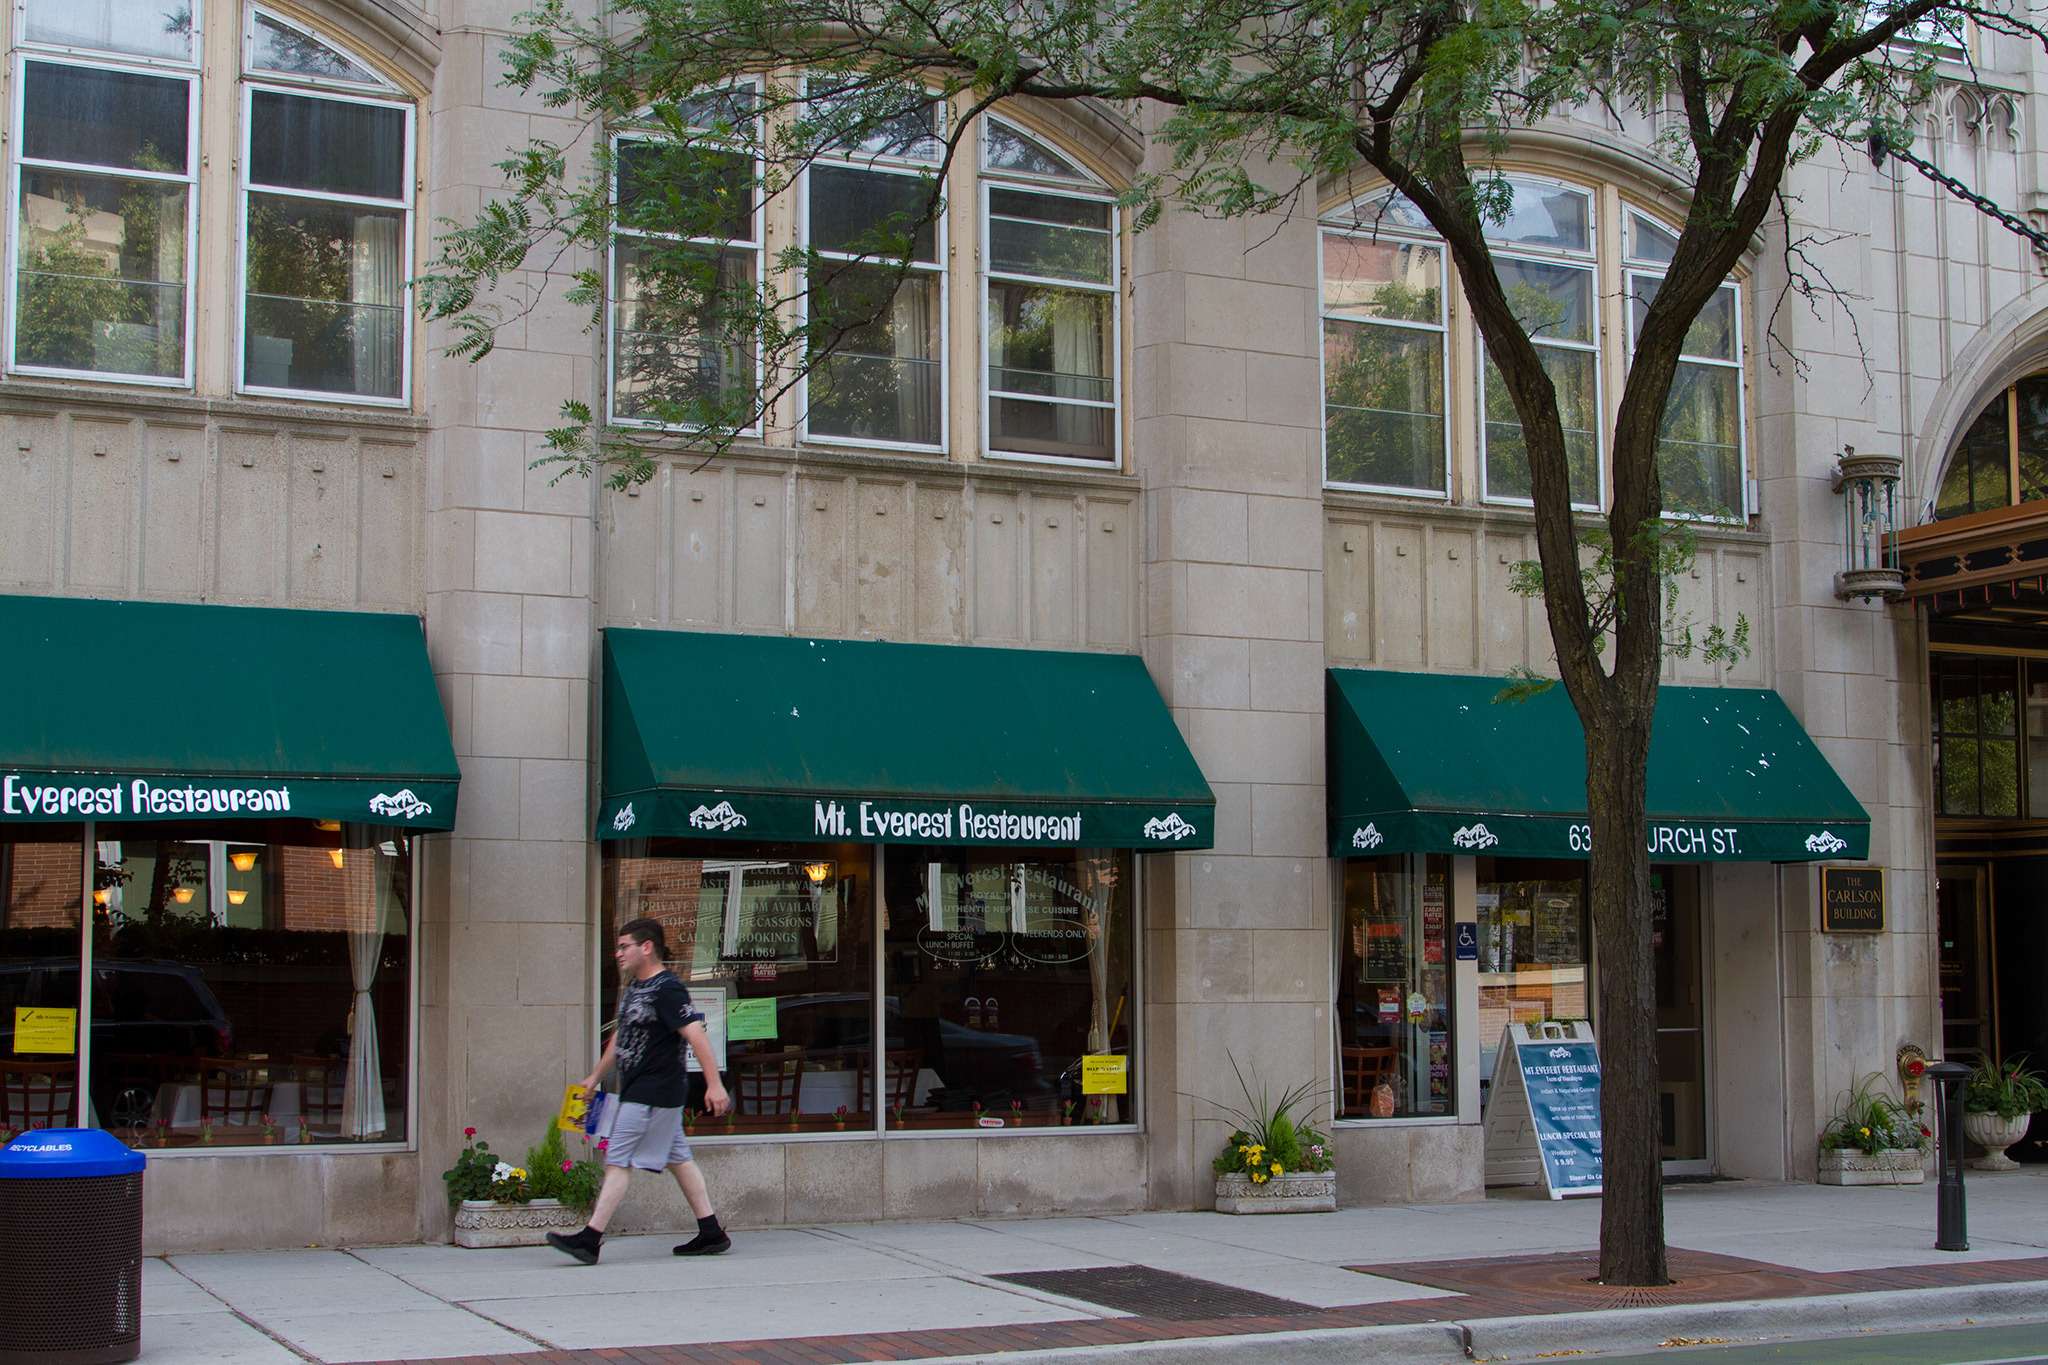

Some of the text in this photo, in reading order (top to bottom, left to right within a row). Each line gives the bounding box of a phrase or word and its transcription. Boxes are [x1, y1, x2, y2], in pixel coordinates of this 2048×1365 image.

[2, 775, 292, 814] Everest Restaurant
[815, 799, 1082, 841] Mt. Everest Restaurant
[1569, 824, 1742, 855] 63 URCH ST.
[741, 863, 786, 875] PECIAL
[1847, 876, 1863, 887] THE
[1012, 864, 1098, 913] estaurant
[1828, 889, 1880, 903] CARLSON
[739, 901, 768, 912] OOM
[939, 905, 1080, 915] UTHENTIC NEPESE CUISINE
[1833, 908, 1877, 920] BUILDING
[711, 932, 734, 943] FO
[738, 931, 798, 943] BOOKINGS
[947, 933, 975, 941] SPECIAL
[1023, 929, 1087, 939] WEEKENDS ONLY
[925, 941, 975, 950] LUNCH BUFFET
[1540, 1130, 1602, 1141] LUNCH SPECIAL BUF
